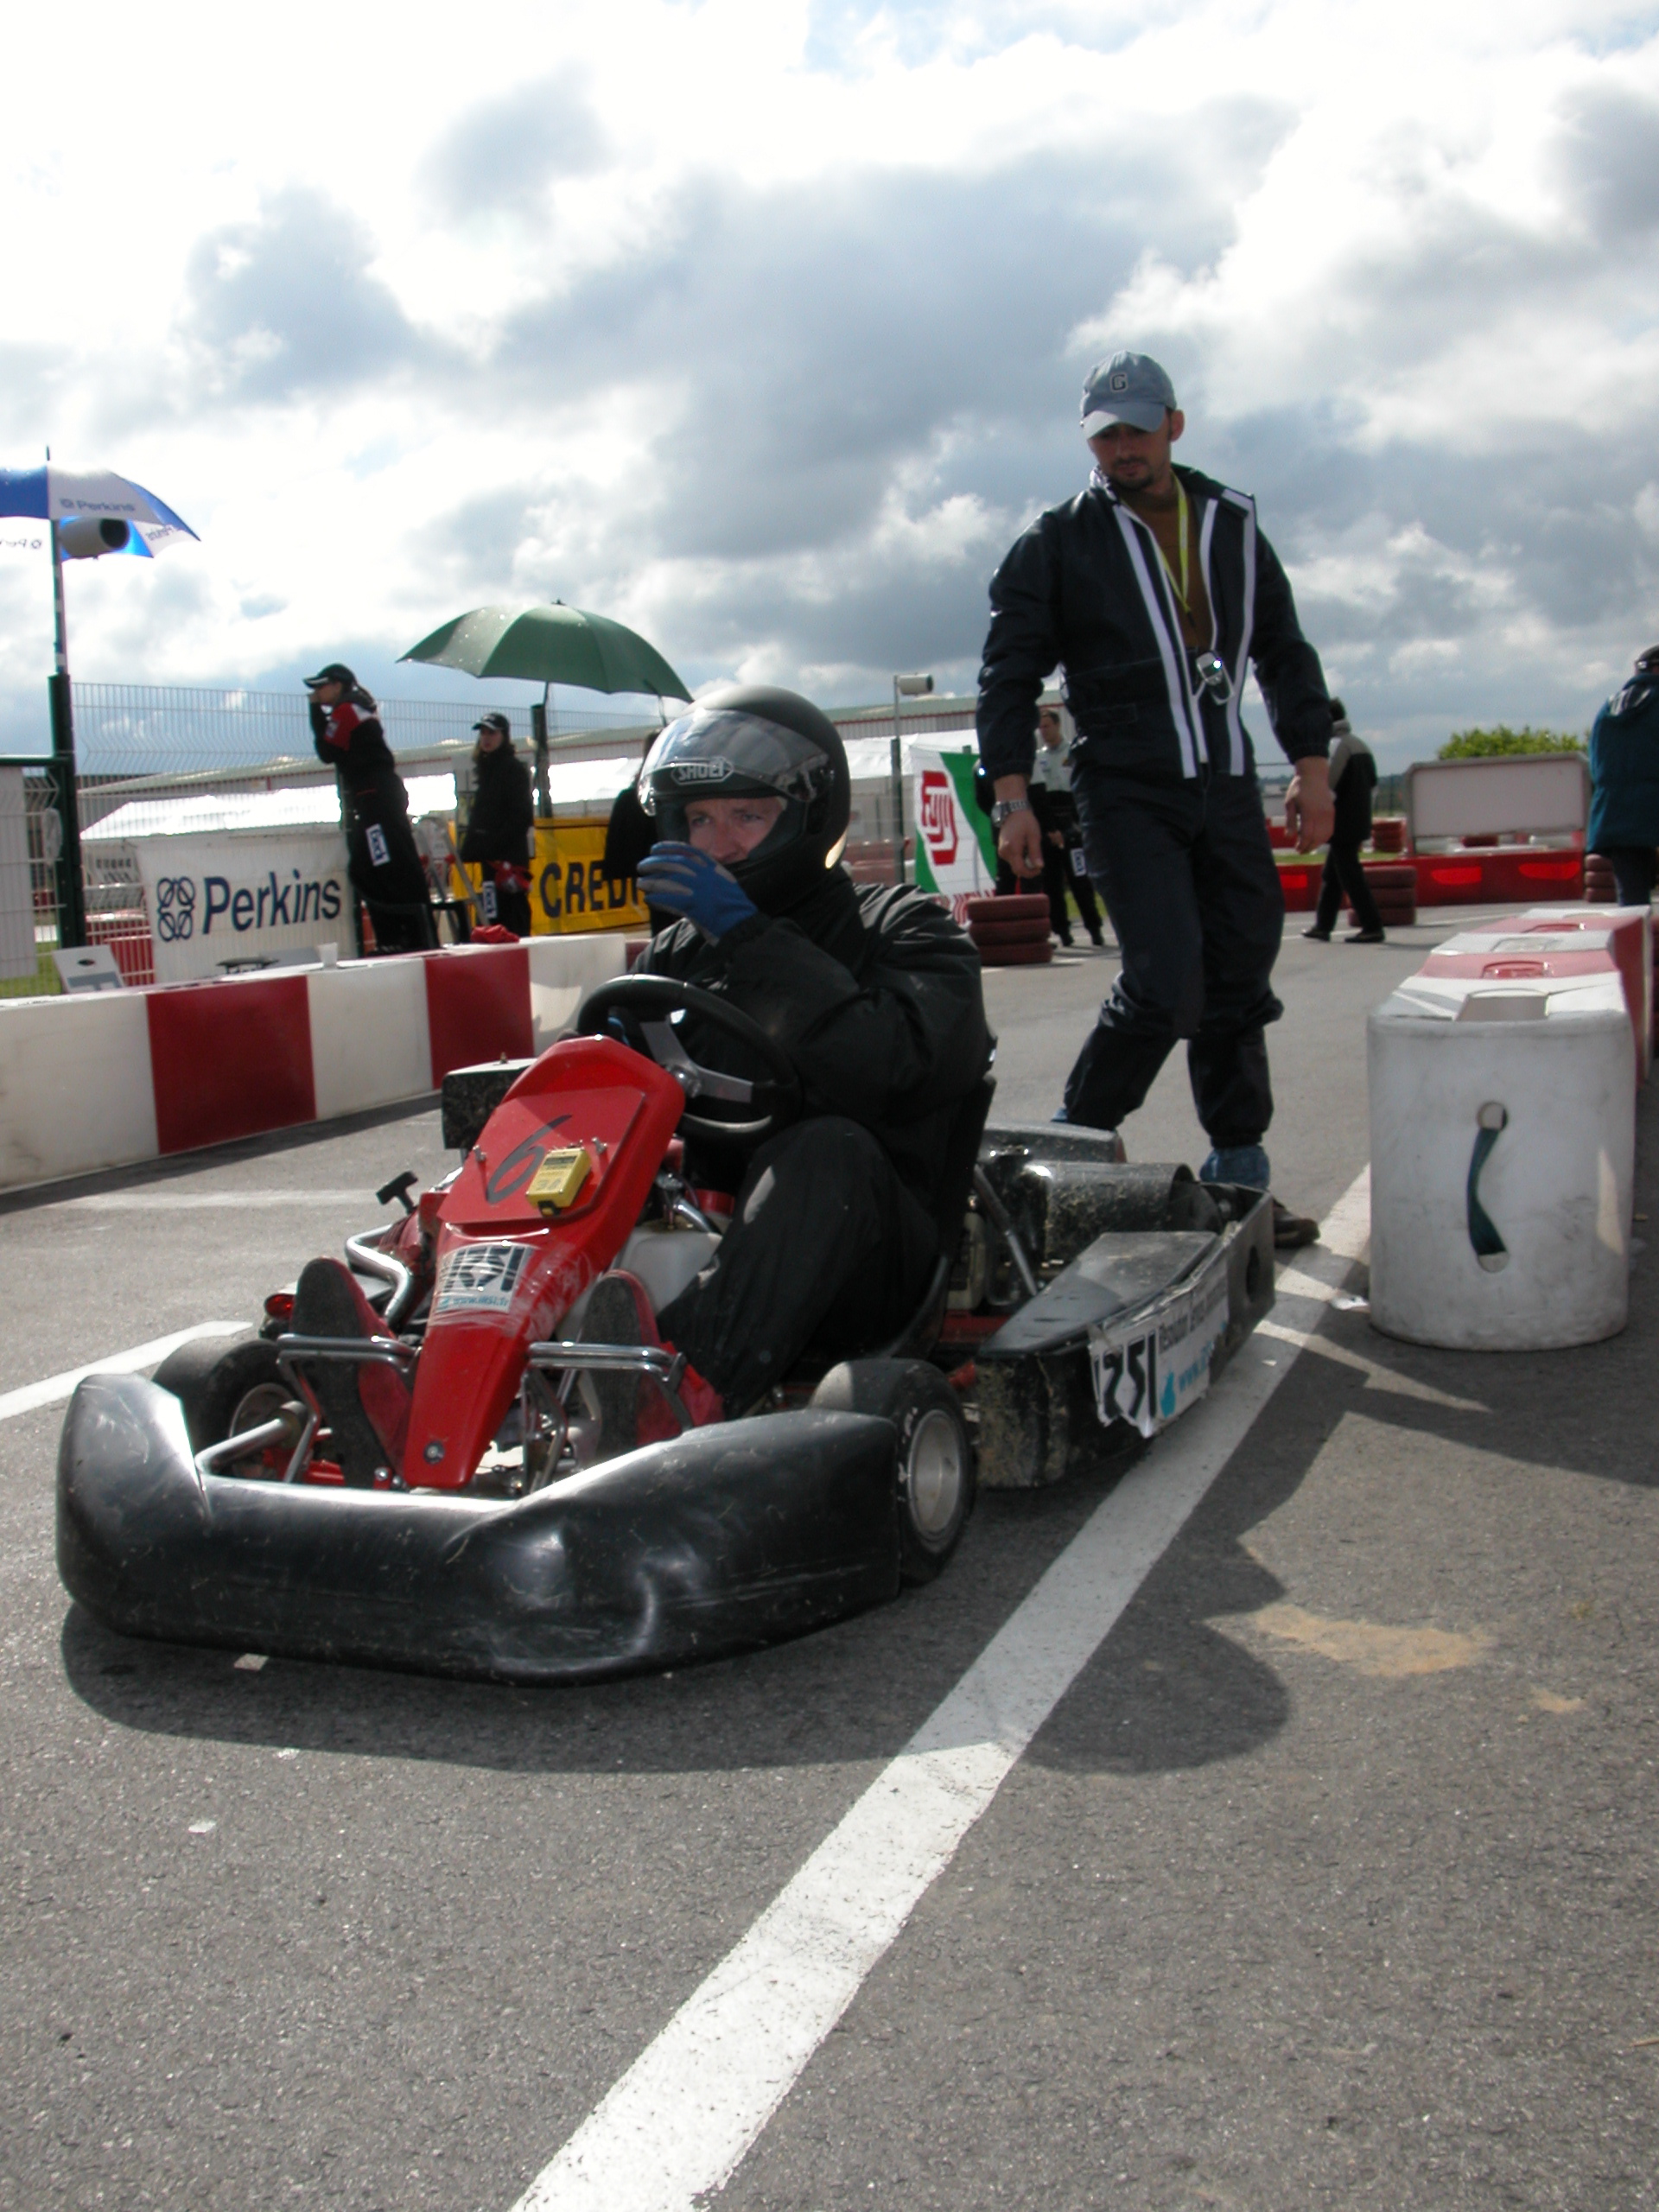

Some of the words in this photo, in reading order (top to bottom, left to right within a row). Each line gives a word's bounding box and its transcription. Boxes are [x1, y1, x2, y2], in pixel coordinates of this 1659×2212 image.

[1110, 372, 1128, 391] G
[677, 760, 725, 781] SHOEI
[202, 868, 341, 935] Perkins
[486, 1114, 574, 1205] 6
